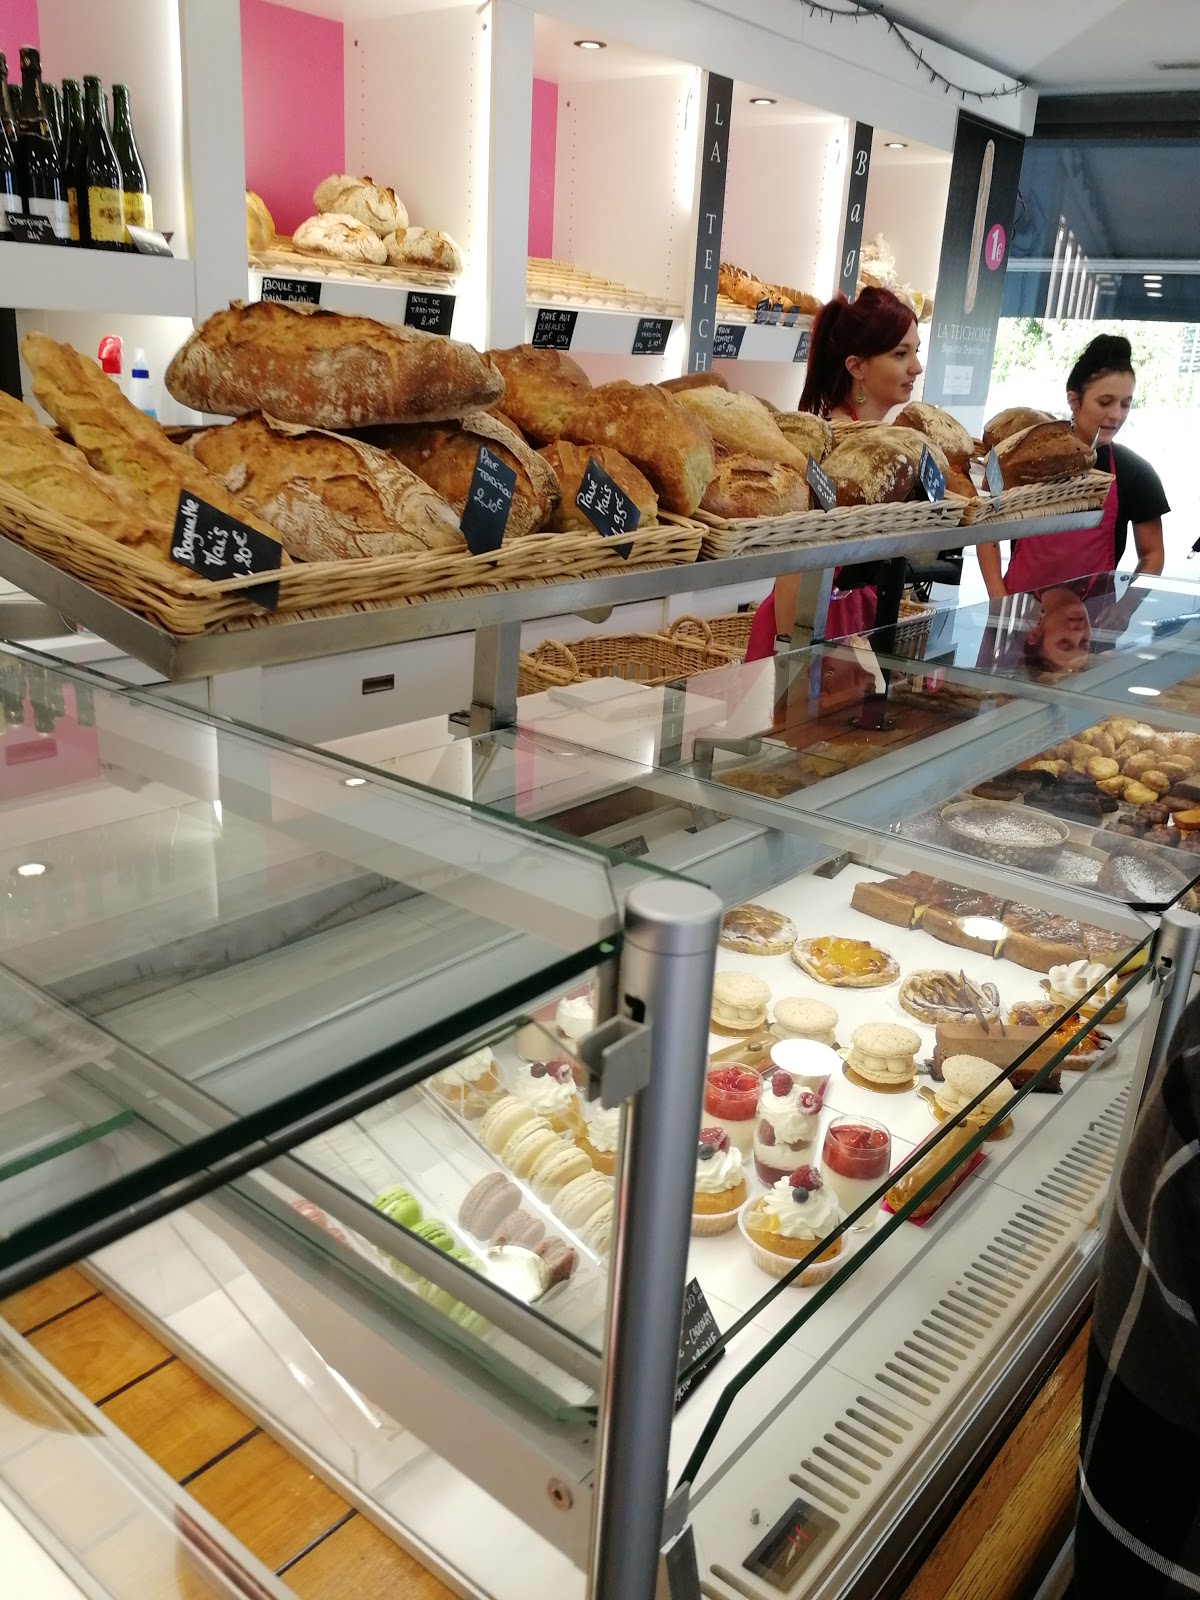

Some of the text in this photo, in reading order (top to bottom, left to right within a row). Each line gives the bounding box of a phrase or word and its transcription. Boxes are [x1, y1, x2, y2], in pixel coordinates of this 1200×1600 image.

[263, 278, 293, 292] BOULE
[937, 323, 992, 343] LA TEICHOISE
[172, 499, 205, 565] Baguette
